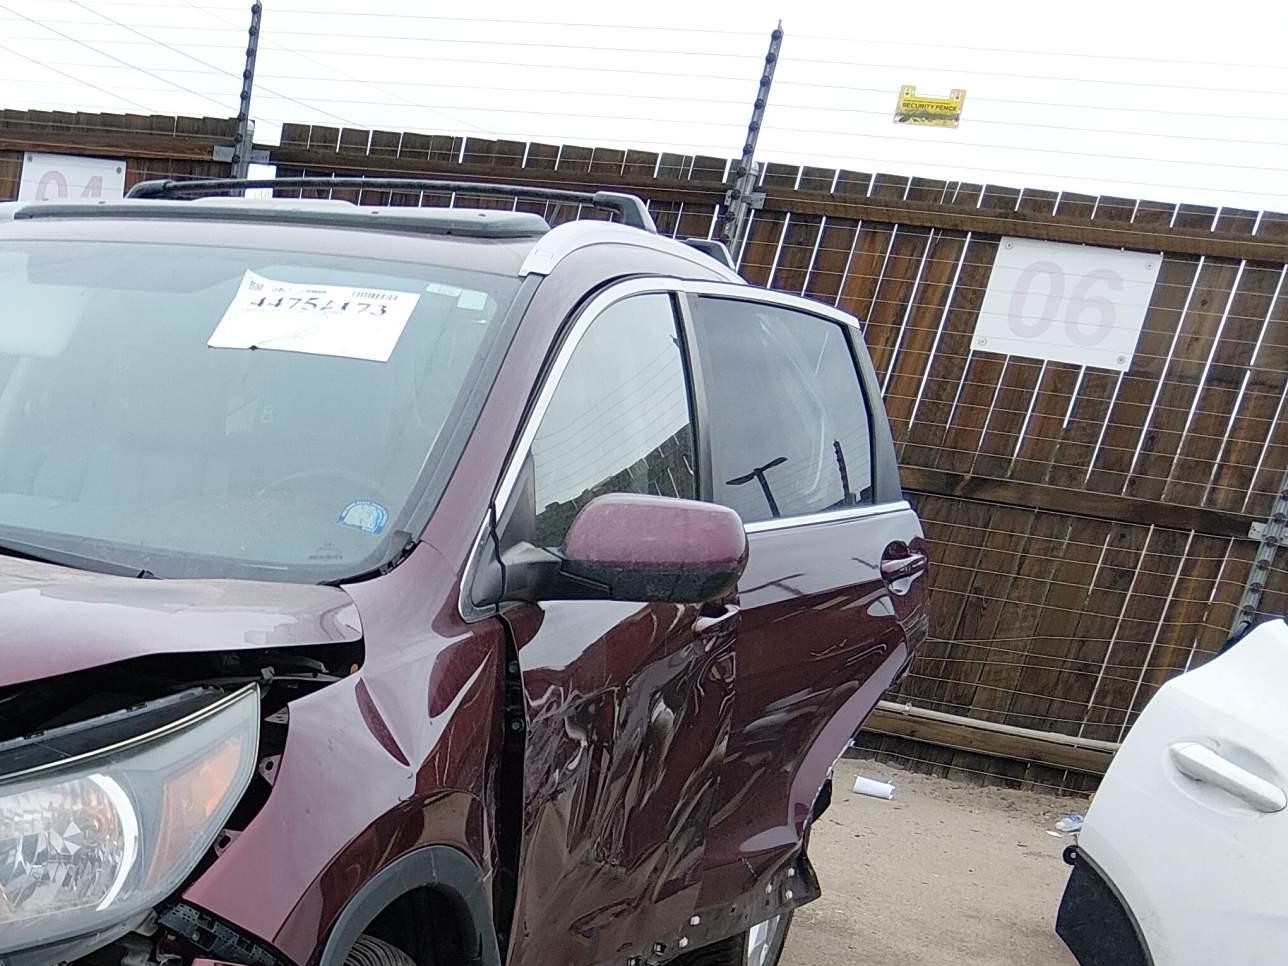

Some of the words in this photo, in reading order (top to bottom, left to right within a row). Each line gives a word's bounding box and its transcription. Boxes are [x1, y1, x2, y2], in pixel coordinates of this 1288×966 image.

[902, 102, 934, 110] SECURITY
[935, 104, 958, 112] FENCE
[1007, 259, 1124, 347] 06
